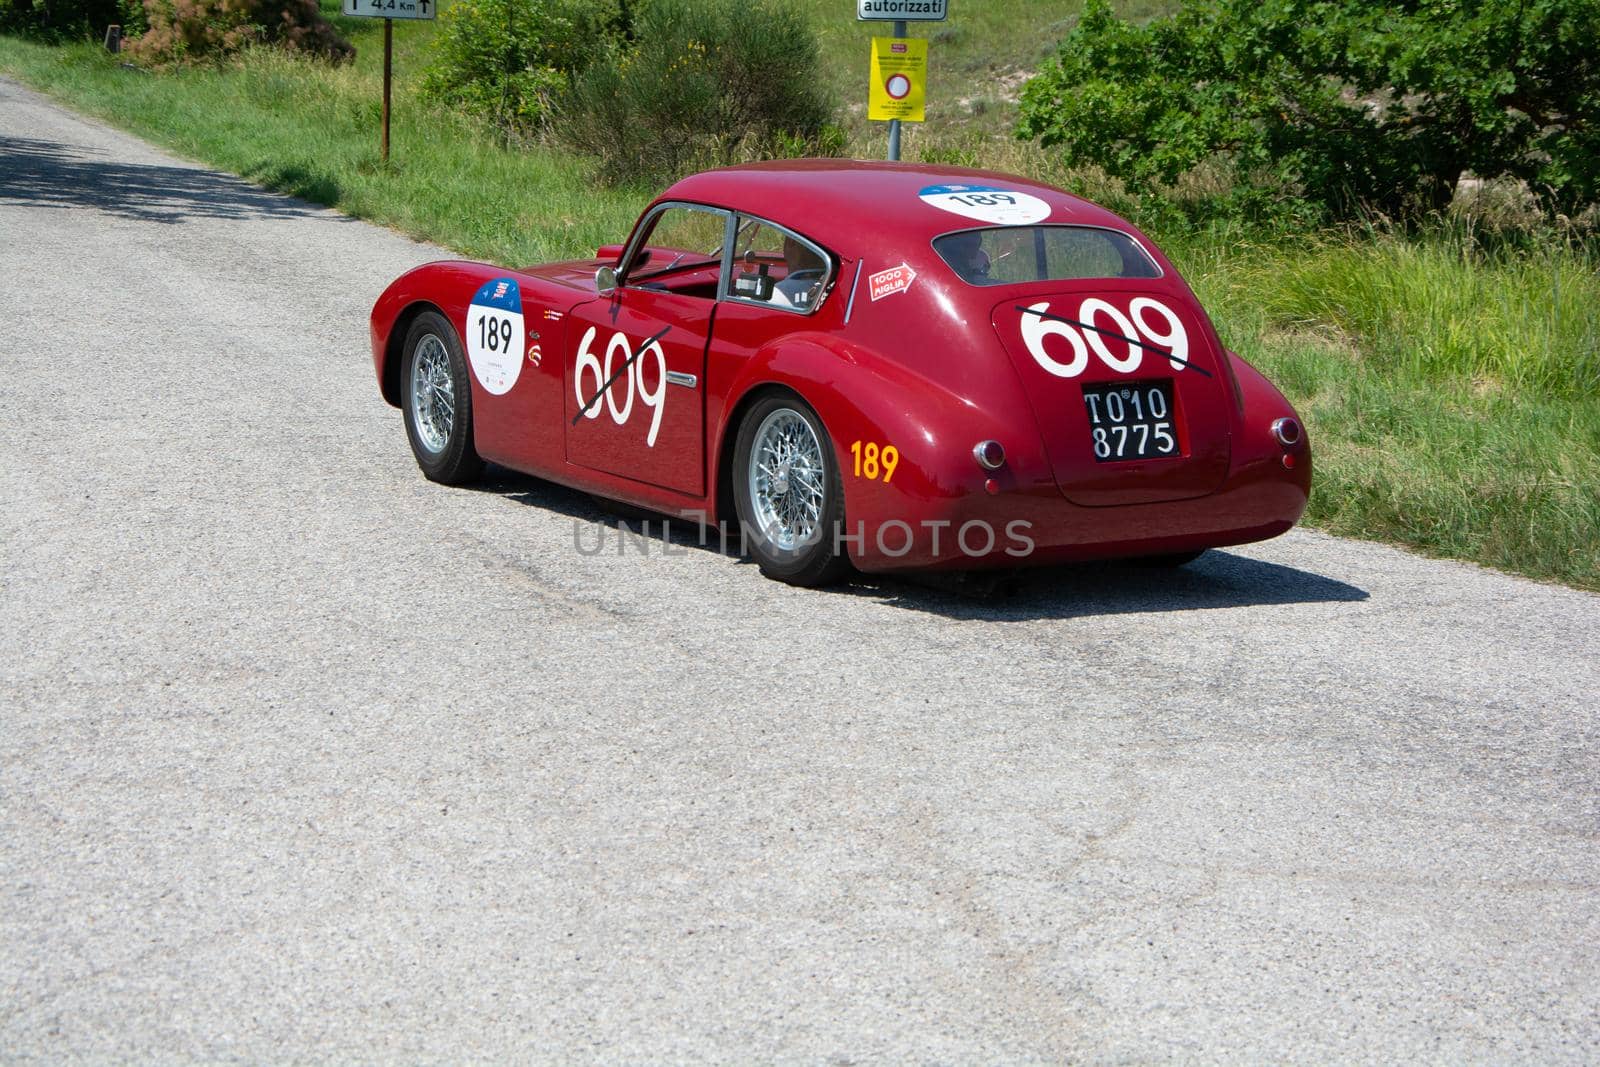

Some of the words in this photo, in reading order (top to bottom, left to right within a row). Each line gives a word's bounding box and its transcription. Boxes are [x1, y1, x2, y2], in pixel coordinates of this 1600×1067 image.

[864, 0, 942, 13] autorizzati
[949, 194, 1017, 207] 189
[874, 270, 902, 285] 1000
[874, 279, 904, 297] MIGLIA
[478, 314, 512, 354] 189
[1020, 297, 1189, 378] 609
[574, 325, 668, 448] 609
[1092, 422, 1174, 458] 8775
[850, 440, 899, 483] 189
